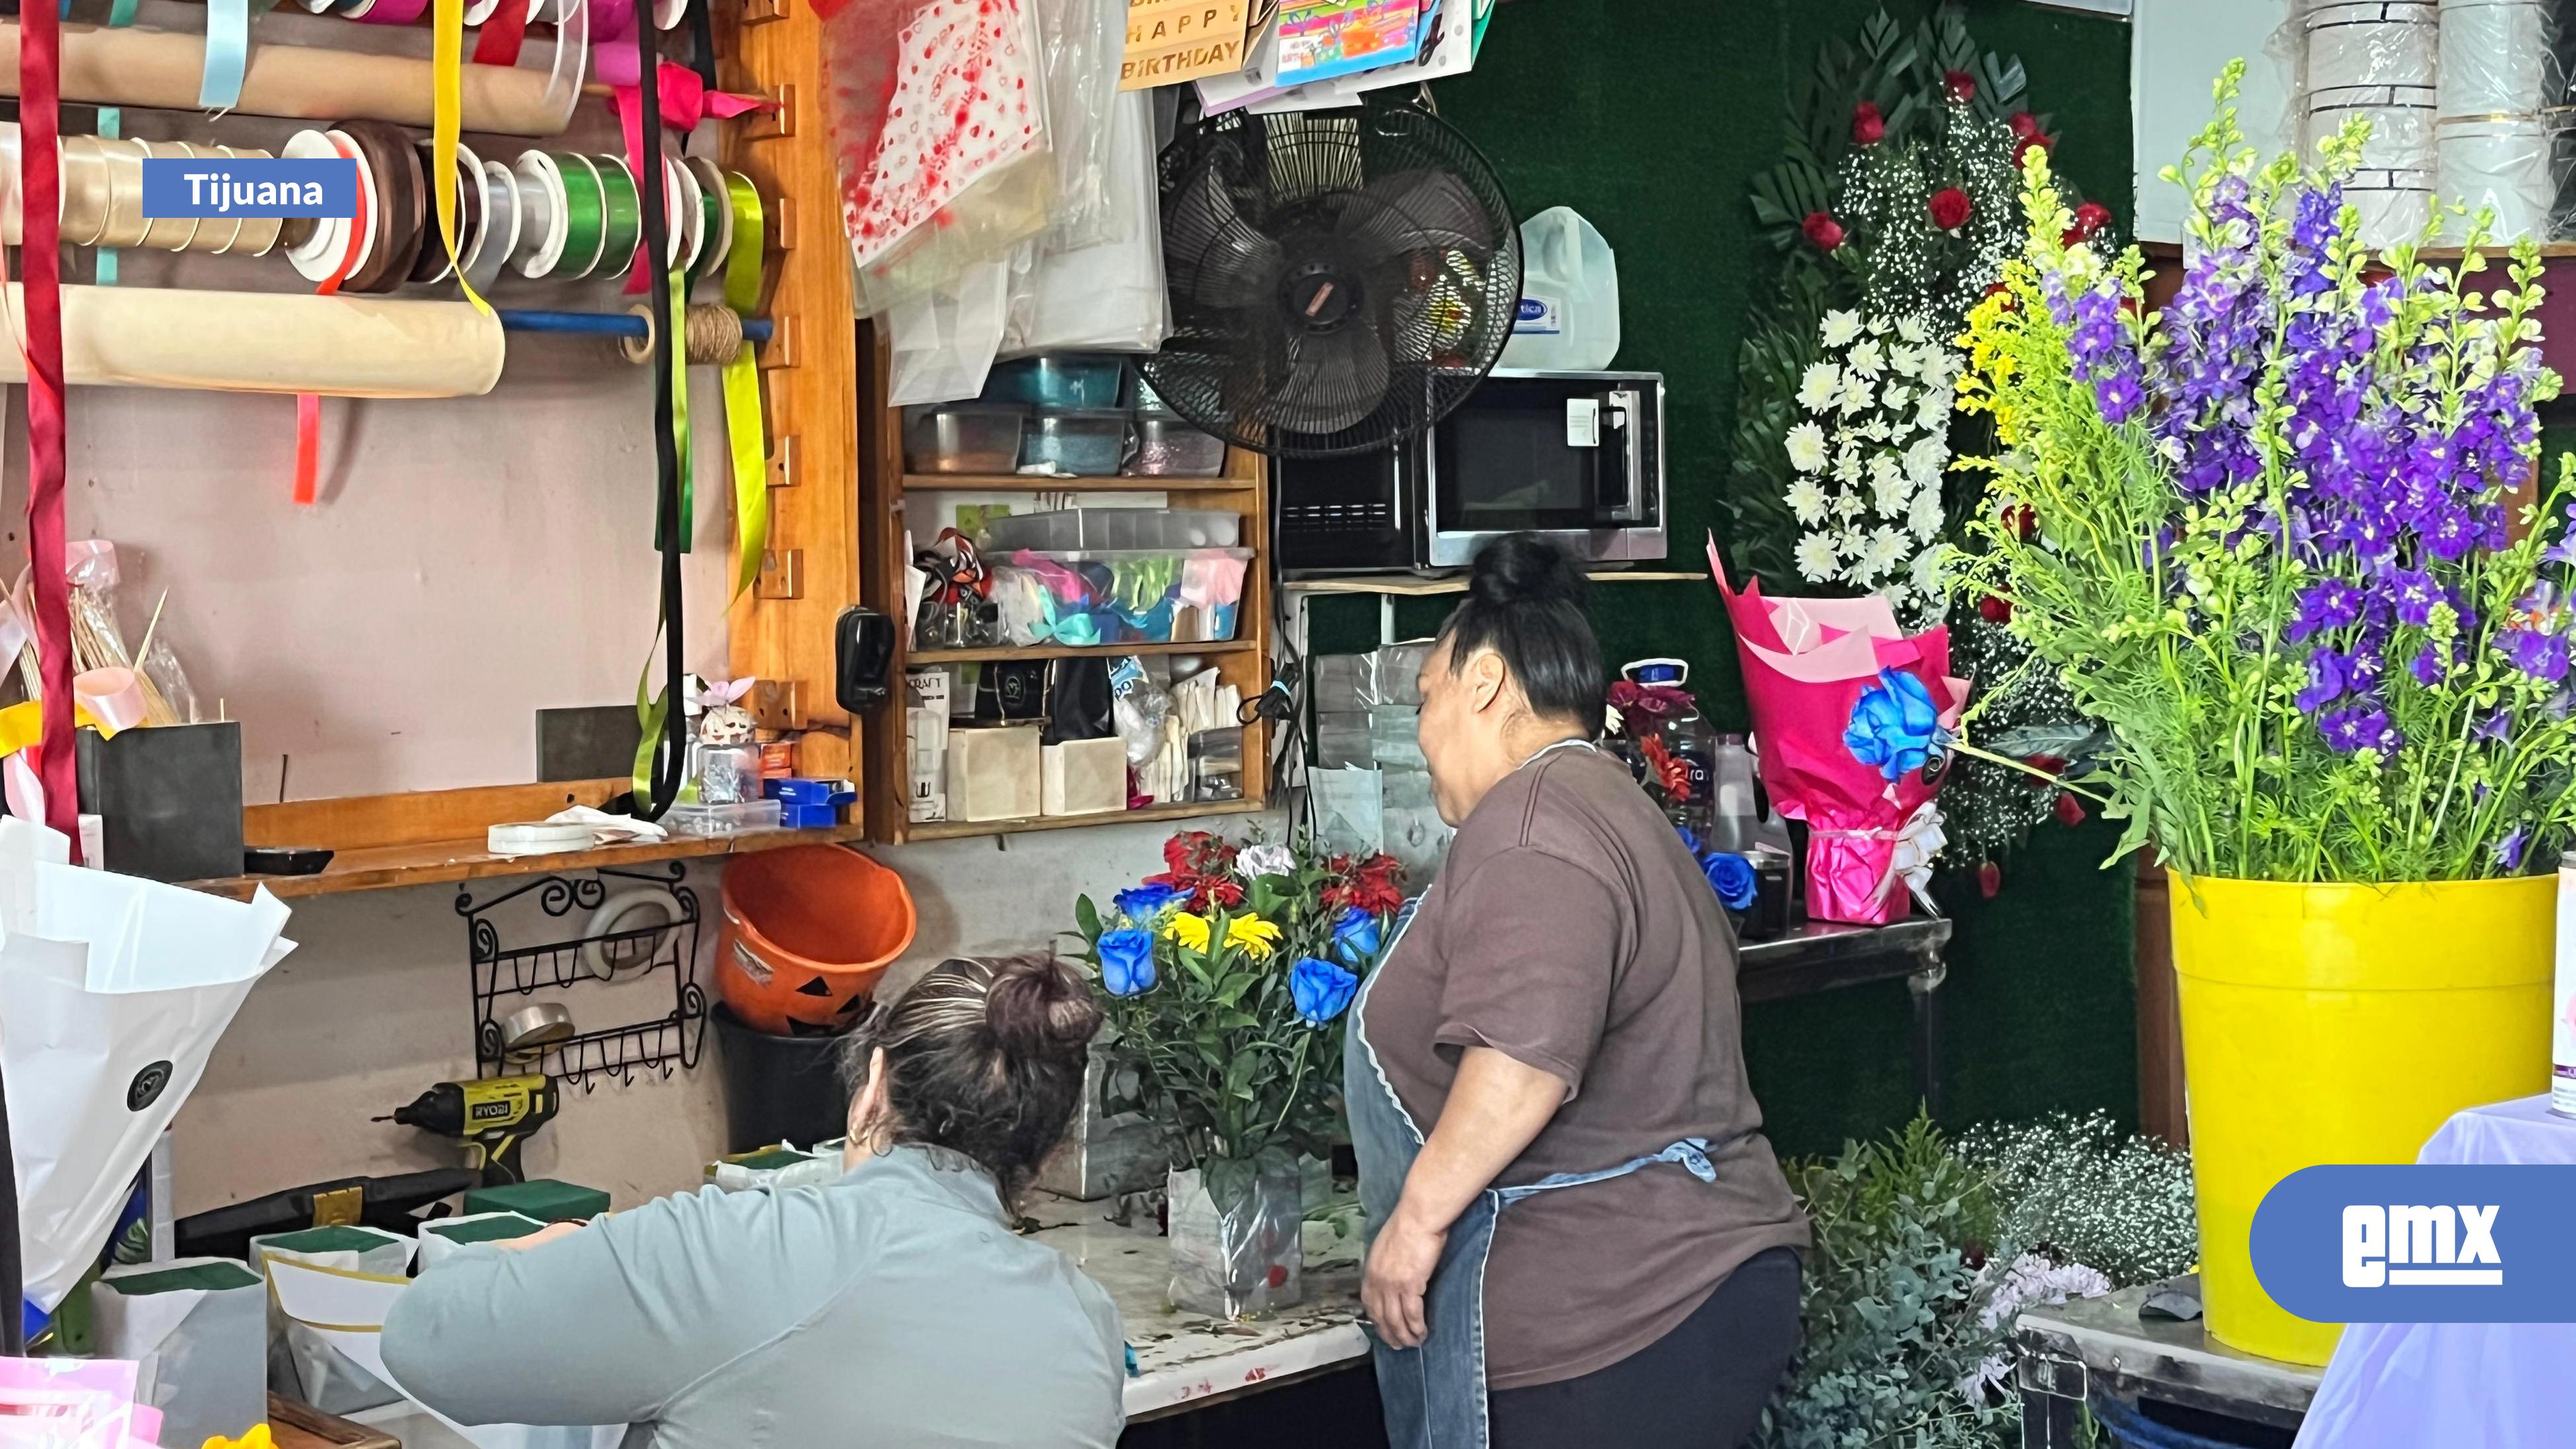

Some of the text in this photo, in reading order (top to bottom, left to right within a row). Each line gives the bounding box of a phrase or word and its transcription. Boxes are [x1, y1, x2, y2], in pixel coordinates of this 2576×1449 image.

[1125, 5, 1240, 44] HAPPY
[1120, 40, 1240, 81] BIRTHDAY
[475, 1103, 508, 1117] RYOBI
